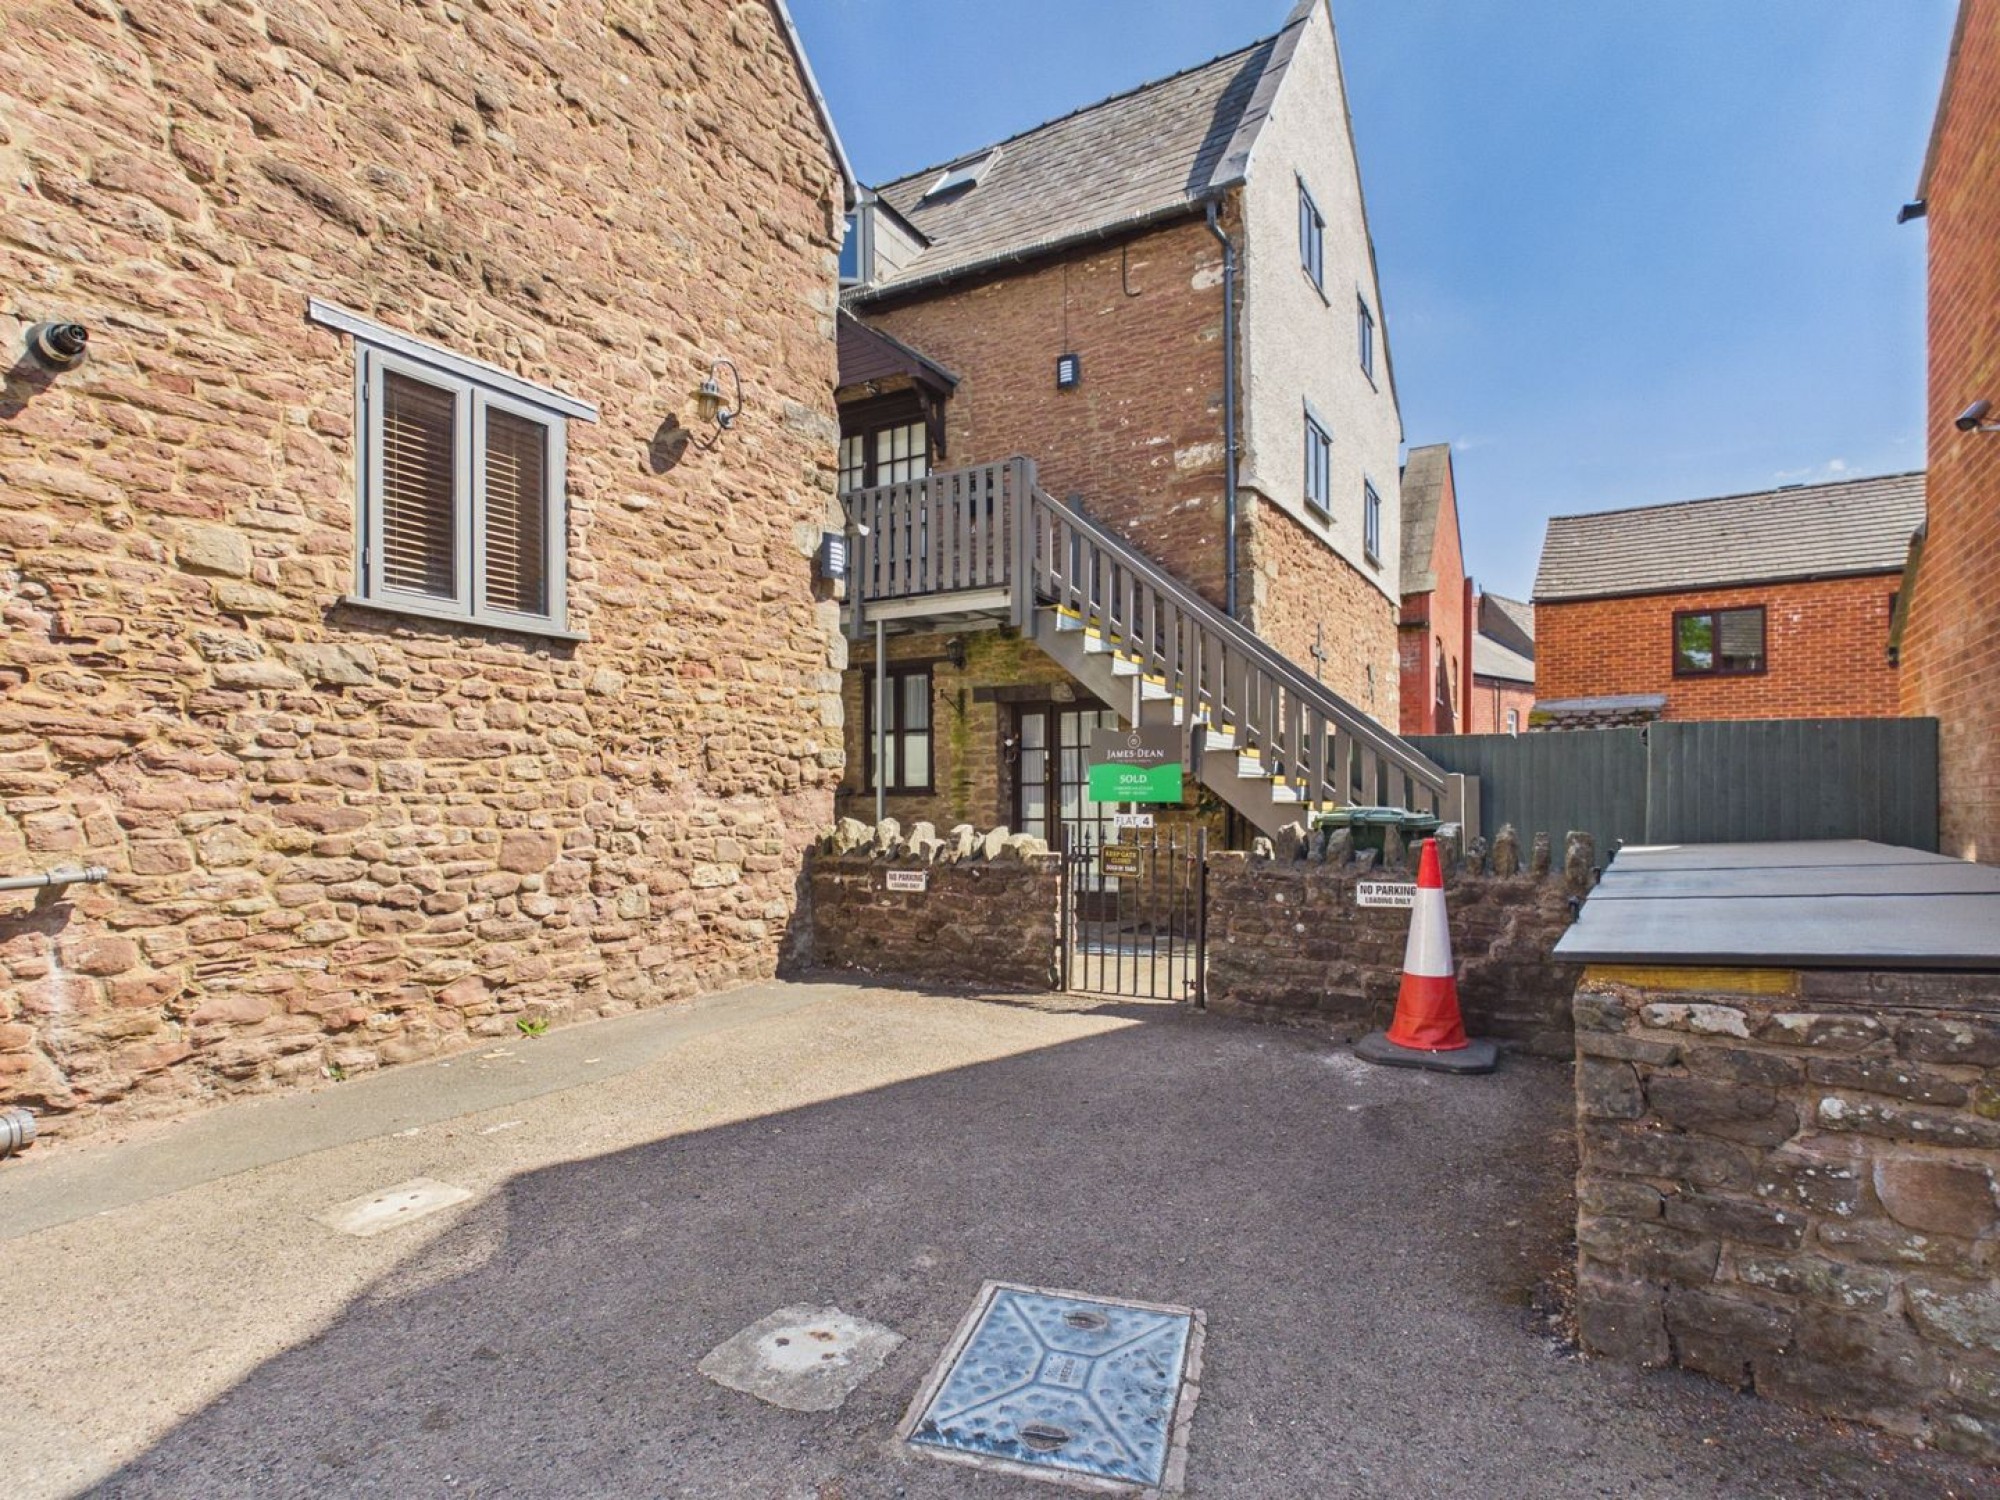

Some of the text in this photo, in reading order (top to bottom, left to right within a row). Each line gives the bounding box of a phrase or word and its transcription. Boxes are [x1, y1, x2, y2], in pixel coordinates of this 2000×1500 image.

[1137, 748, 1164, 758] DEAN
[1120, 774, 1147, 784] SOLD
[1115, 816, 1150, 825] FLAT 4
[898, 874, 923, 882] PARKING
[1360, 885, 1417, 896] NO PARKING
